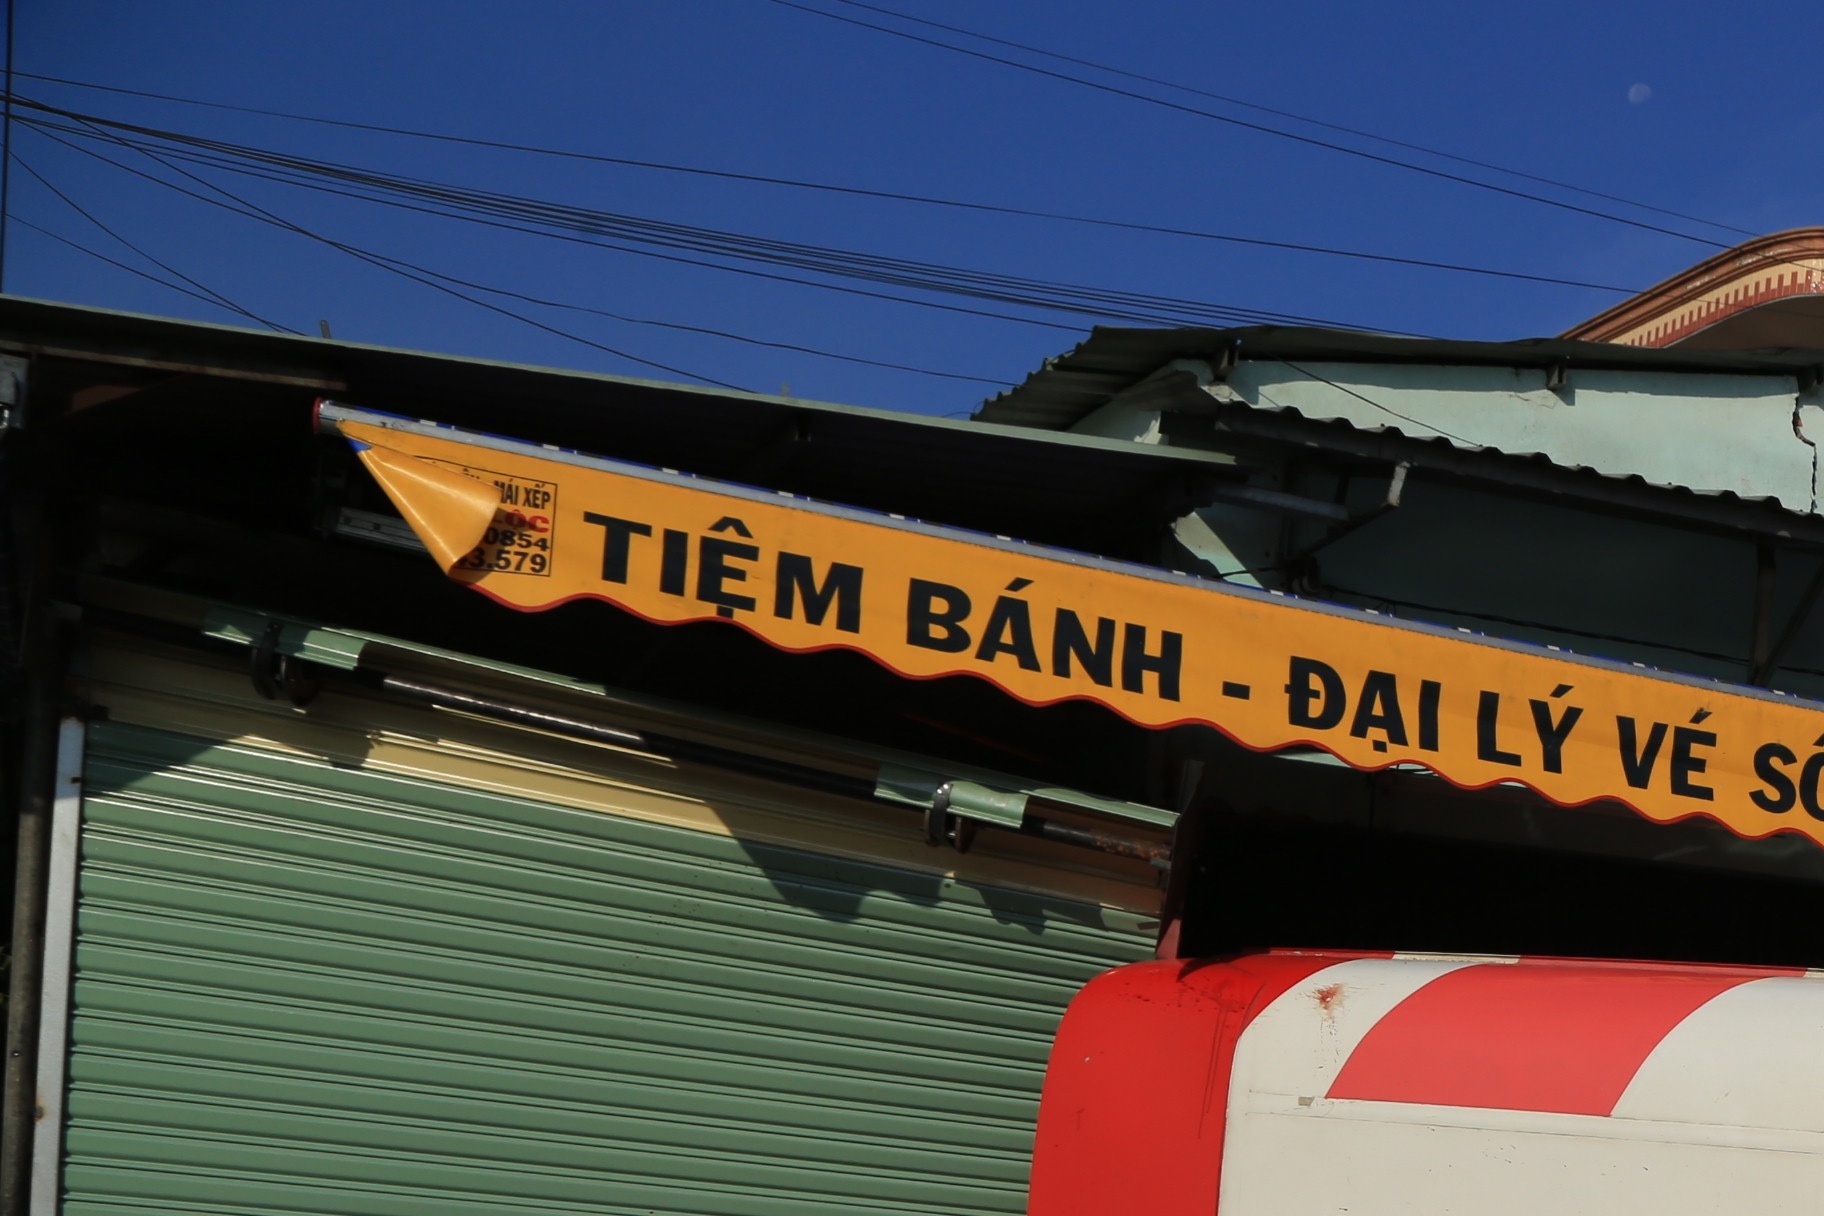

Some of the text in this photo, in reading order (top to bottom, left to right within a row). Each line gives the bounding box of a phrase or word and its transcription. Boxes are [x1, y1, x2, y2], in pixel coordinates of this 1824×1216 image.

[522, 483, 551, 510] XẾP
[484, 527, 550, 552] 0854
[584, 516, 864, 634] TIỆM
[906, 577, 1183, 702] BÁNH
[1222, 681, 1251, 701] -
[1284, 655, 1441, 753] ĐẠI
[1476, 683, 1583, 774] LÝ
[1615, 708, 1718, 801] VÉ
